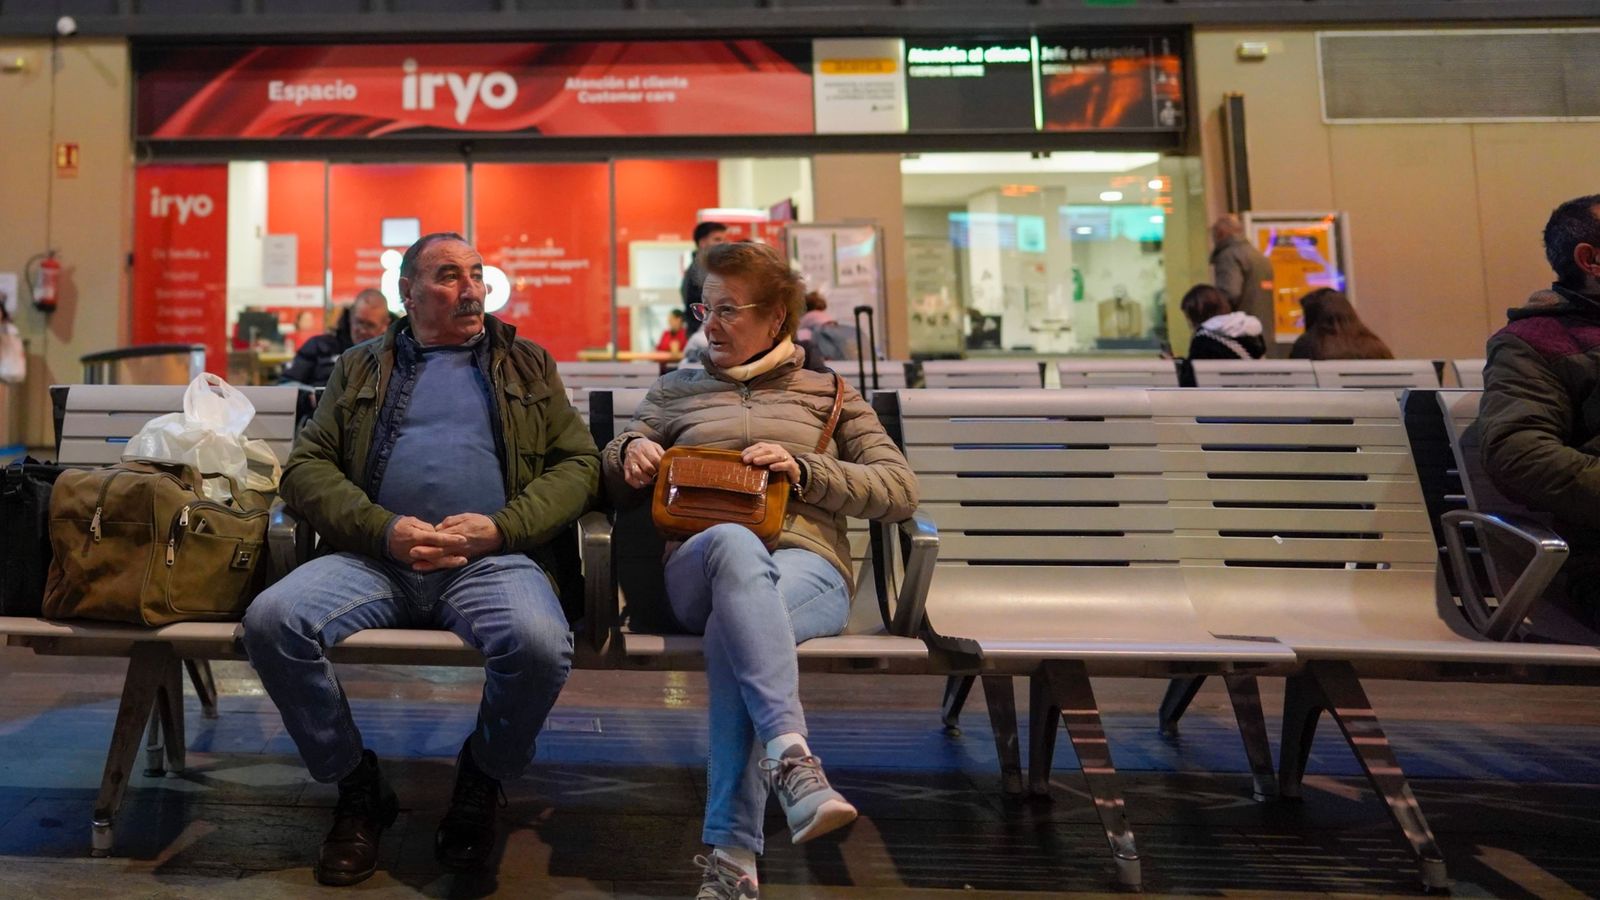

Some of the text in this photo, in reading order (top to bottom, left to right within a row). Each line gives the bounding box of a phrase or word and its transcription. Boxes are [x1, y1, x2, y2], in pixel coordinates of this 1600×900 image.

[1070, 46, 1088, 60] de
[267, 79, 358, 106] Espacio
[402, 58, 518, 125] iryo
[642, 76, 689, 90] cliente
[577, 91, 677, 104] Customer care
[150, 187, 214, 225] iryo
